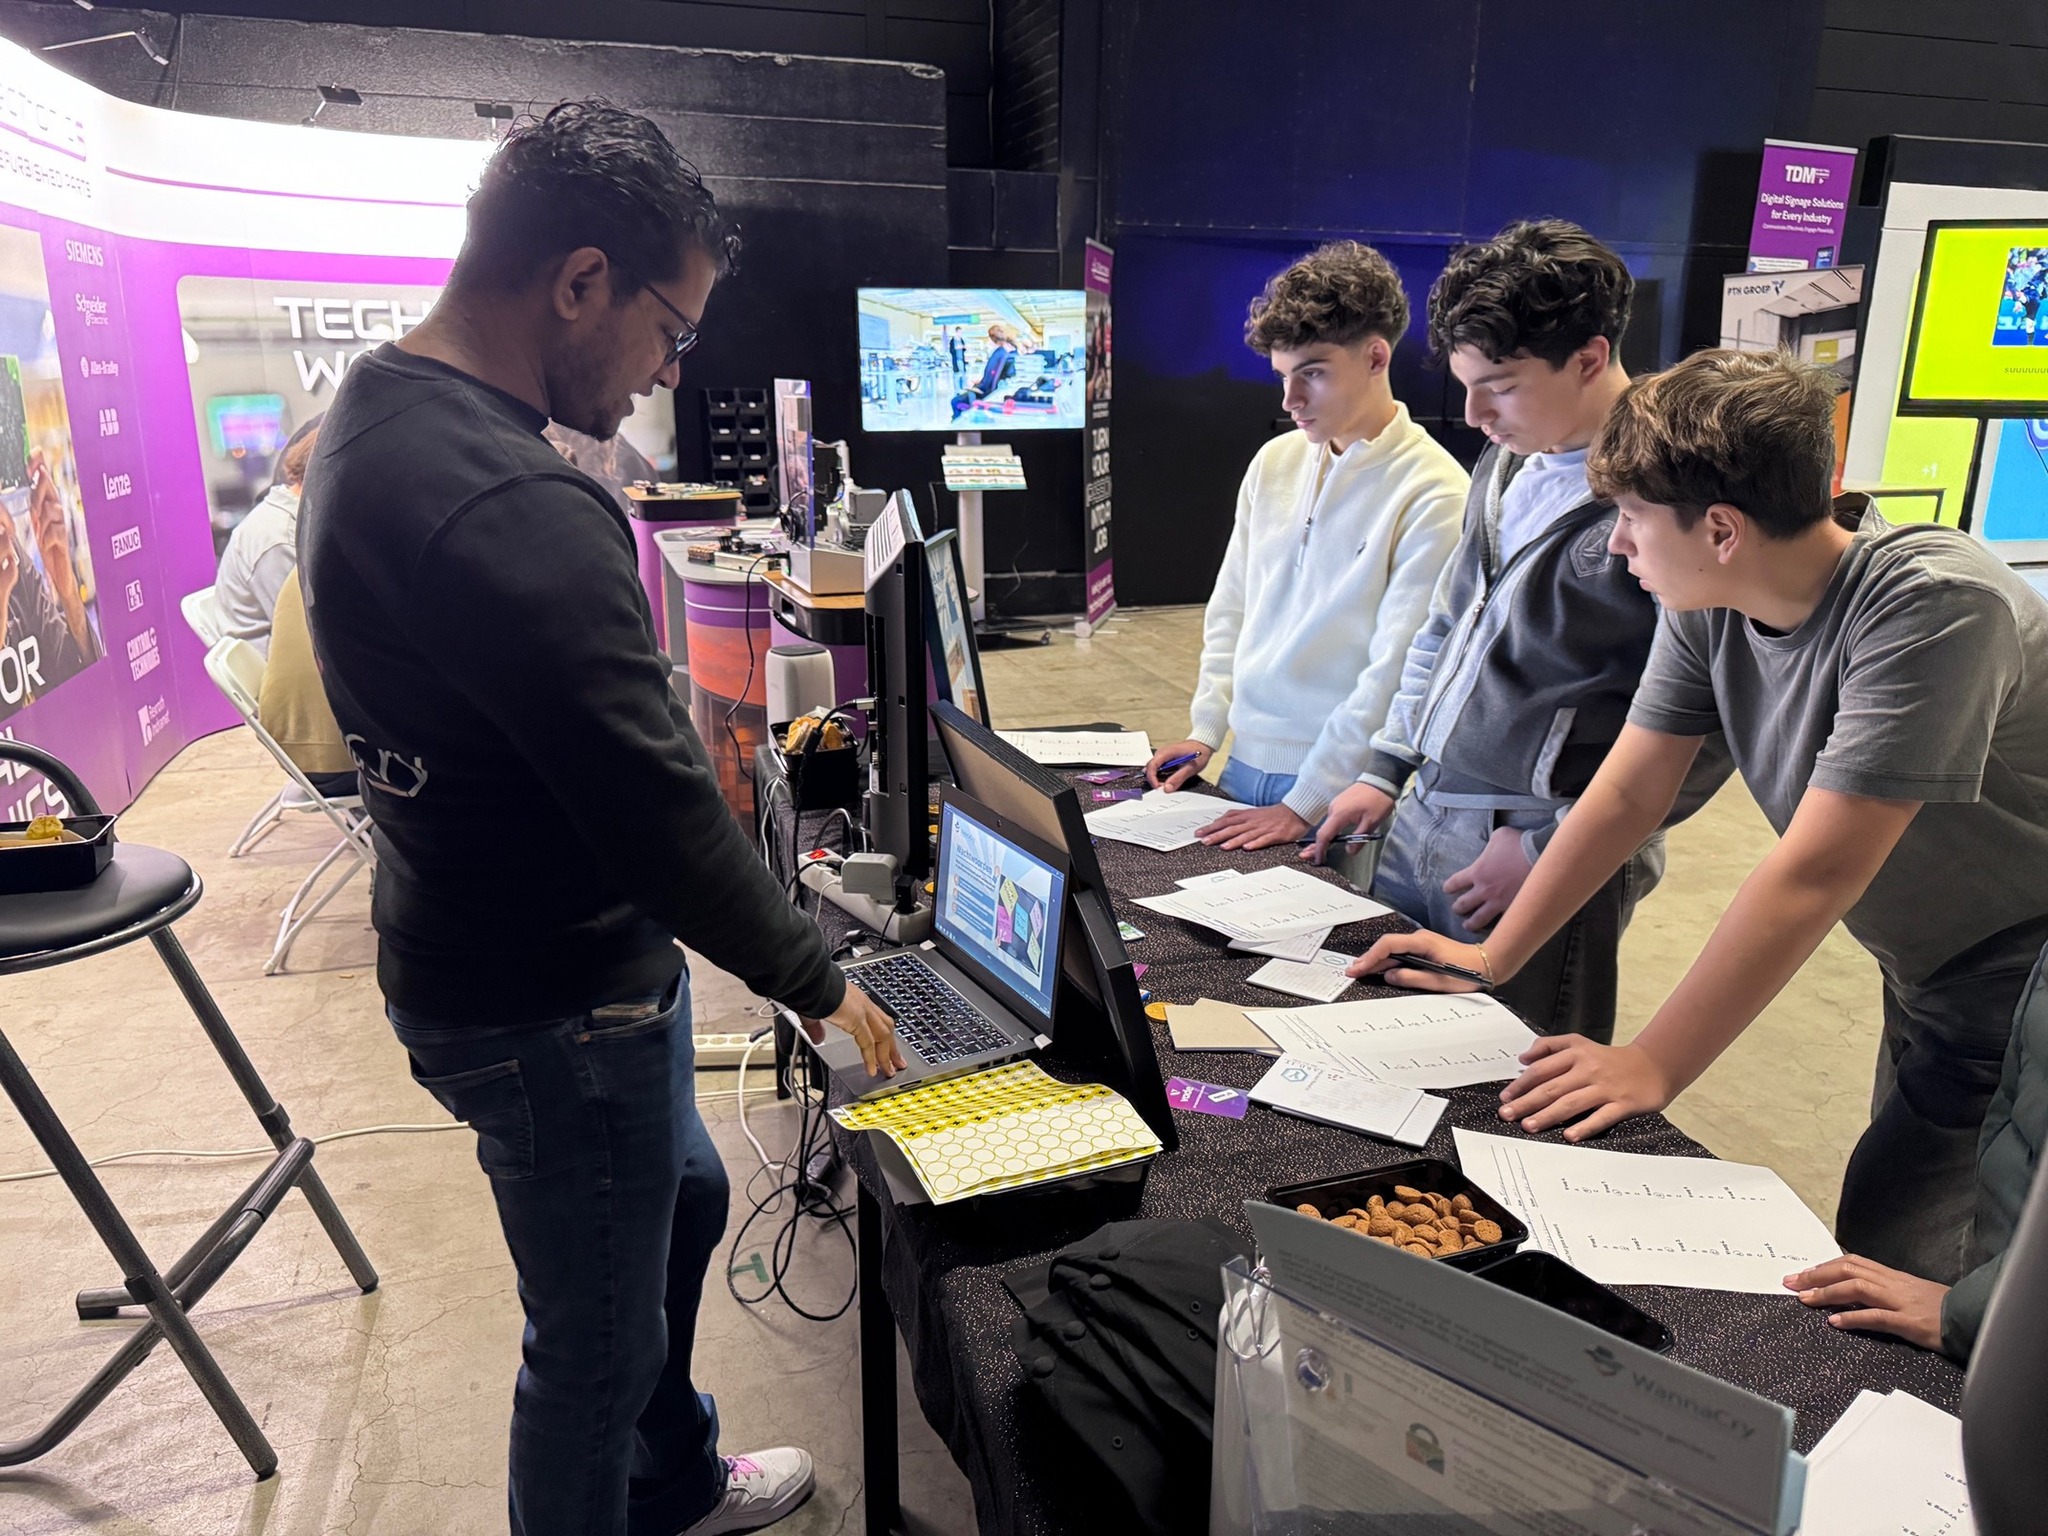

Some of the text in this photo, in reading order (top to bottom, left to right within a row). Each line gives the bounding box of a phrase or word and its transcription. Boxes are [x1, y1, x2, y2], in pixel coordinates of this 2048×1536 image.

[1785, 165, 1816, 184] TDM
[1761, 193, 1844, 210] Digital Signage Solutions
[1771, 209, 1832, 225] for Every Industry
[66, 239, 104, 267] SIEMENS
[1743, 285, 1771, 295] GROEP
[75, 293, 107, 314] Schneider
[99, 408, 119, 437] ABB
[103, 473, 132, 500] Lenze
[113, 531, 140, 558] FANUC
[957, 844, 992, 875] Wachtwoorden
[1180, 1086, 1195, 1102] vade
[1632, 1370, 1756, 1440] WannaCry
[1934, 1504, 1957, 1520] Vraag
